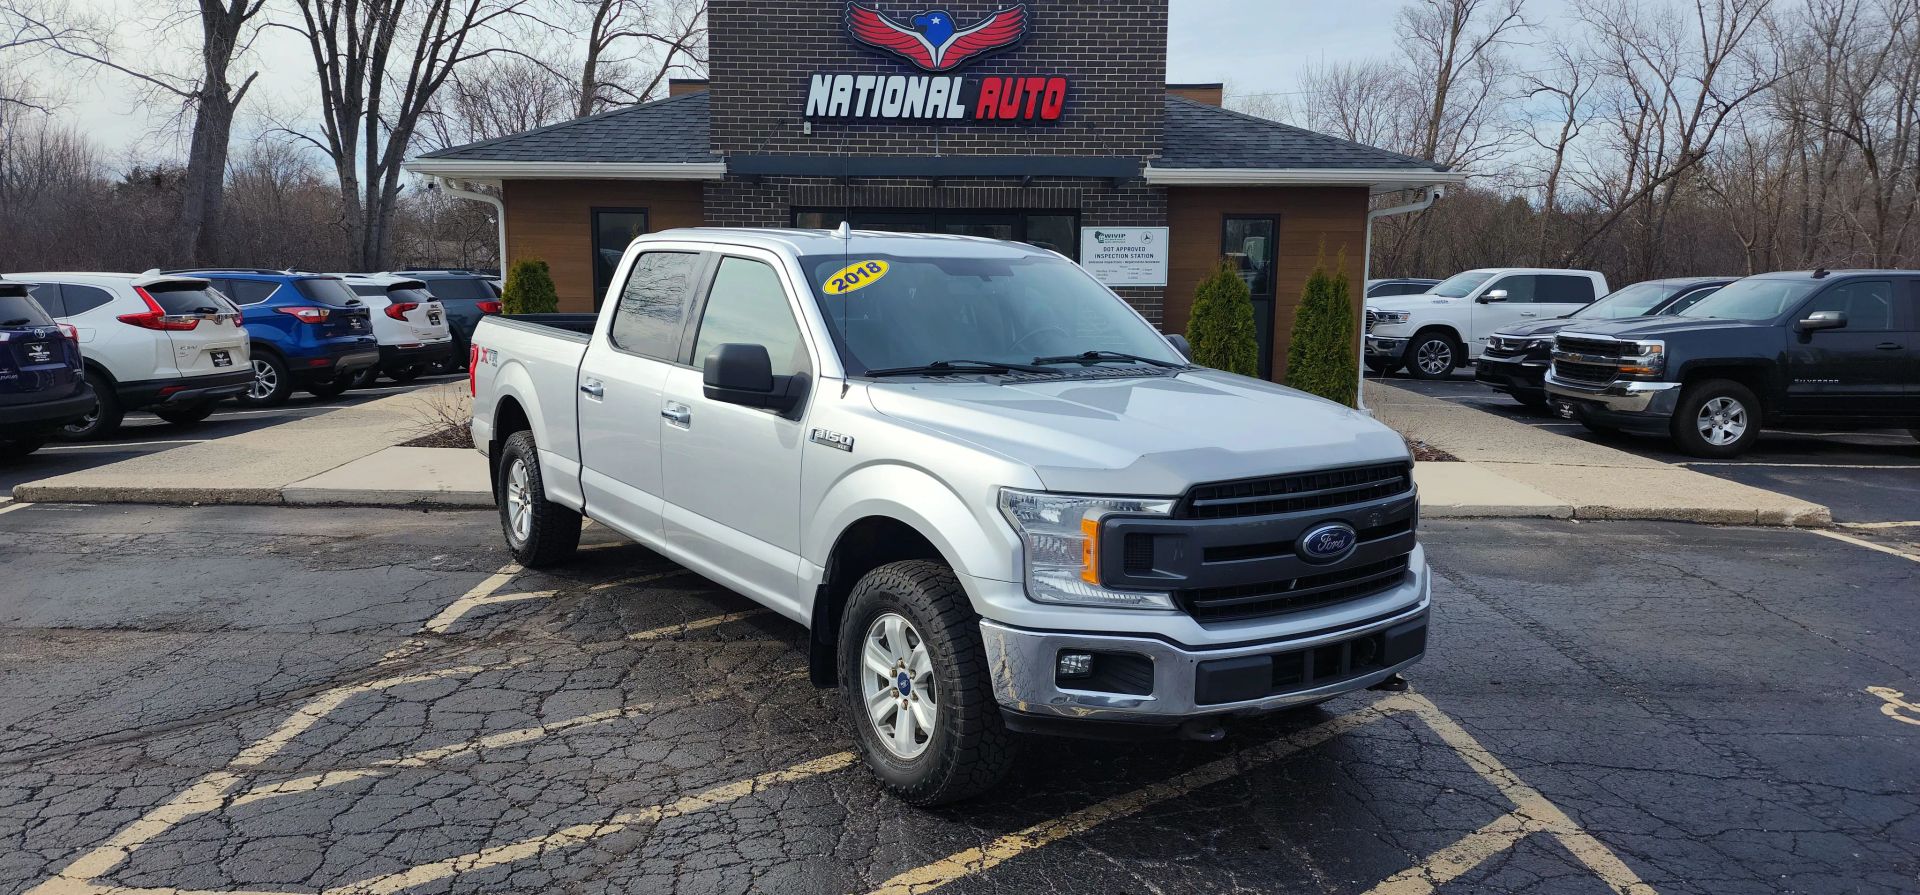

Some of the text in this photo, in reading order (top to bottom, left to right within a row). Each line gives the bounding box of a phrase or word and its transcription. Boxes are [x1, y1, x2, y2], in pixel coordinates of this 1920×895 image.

[805, 74, 1067, 120] NATIONAL AUTO
[831, 261, 881, 292] 2018
[1318, 532, 1346, 552] Ford
